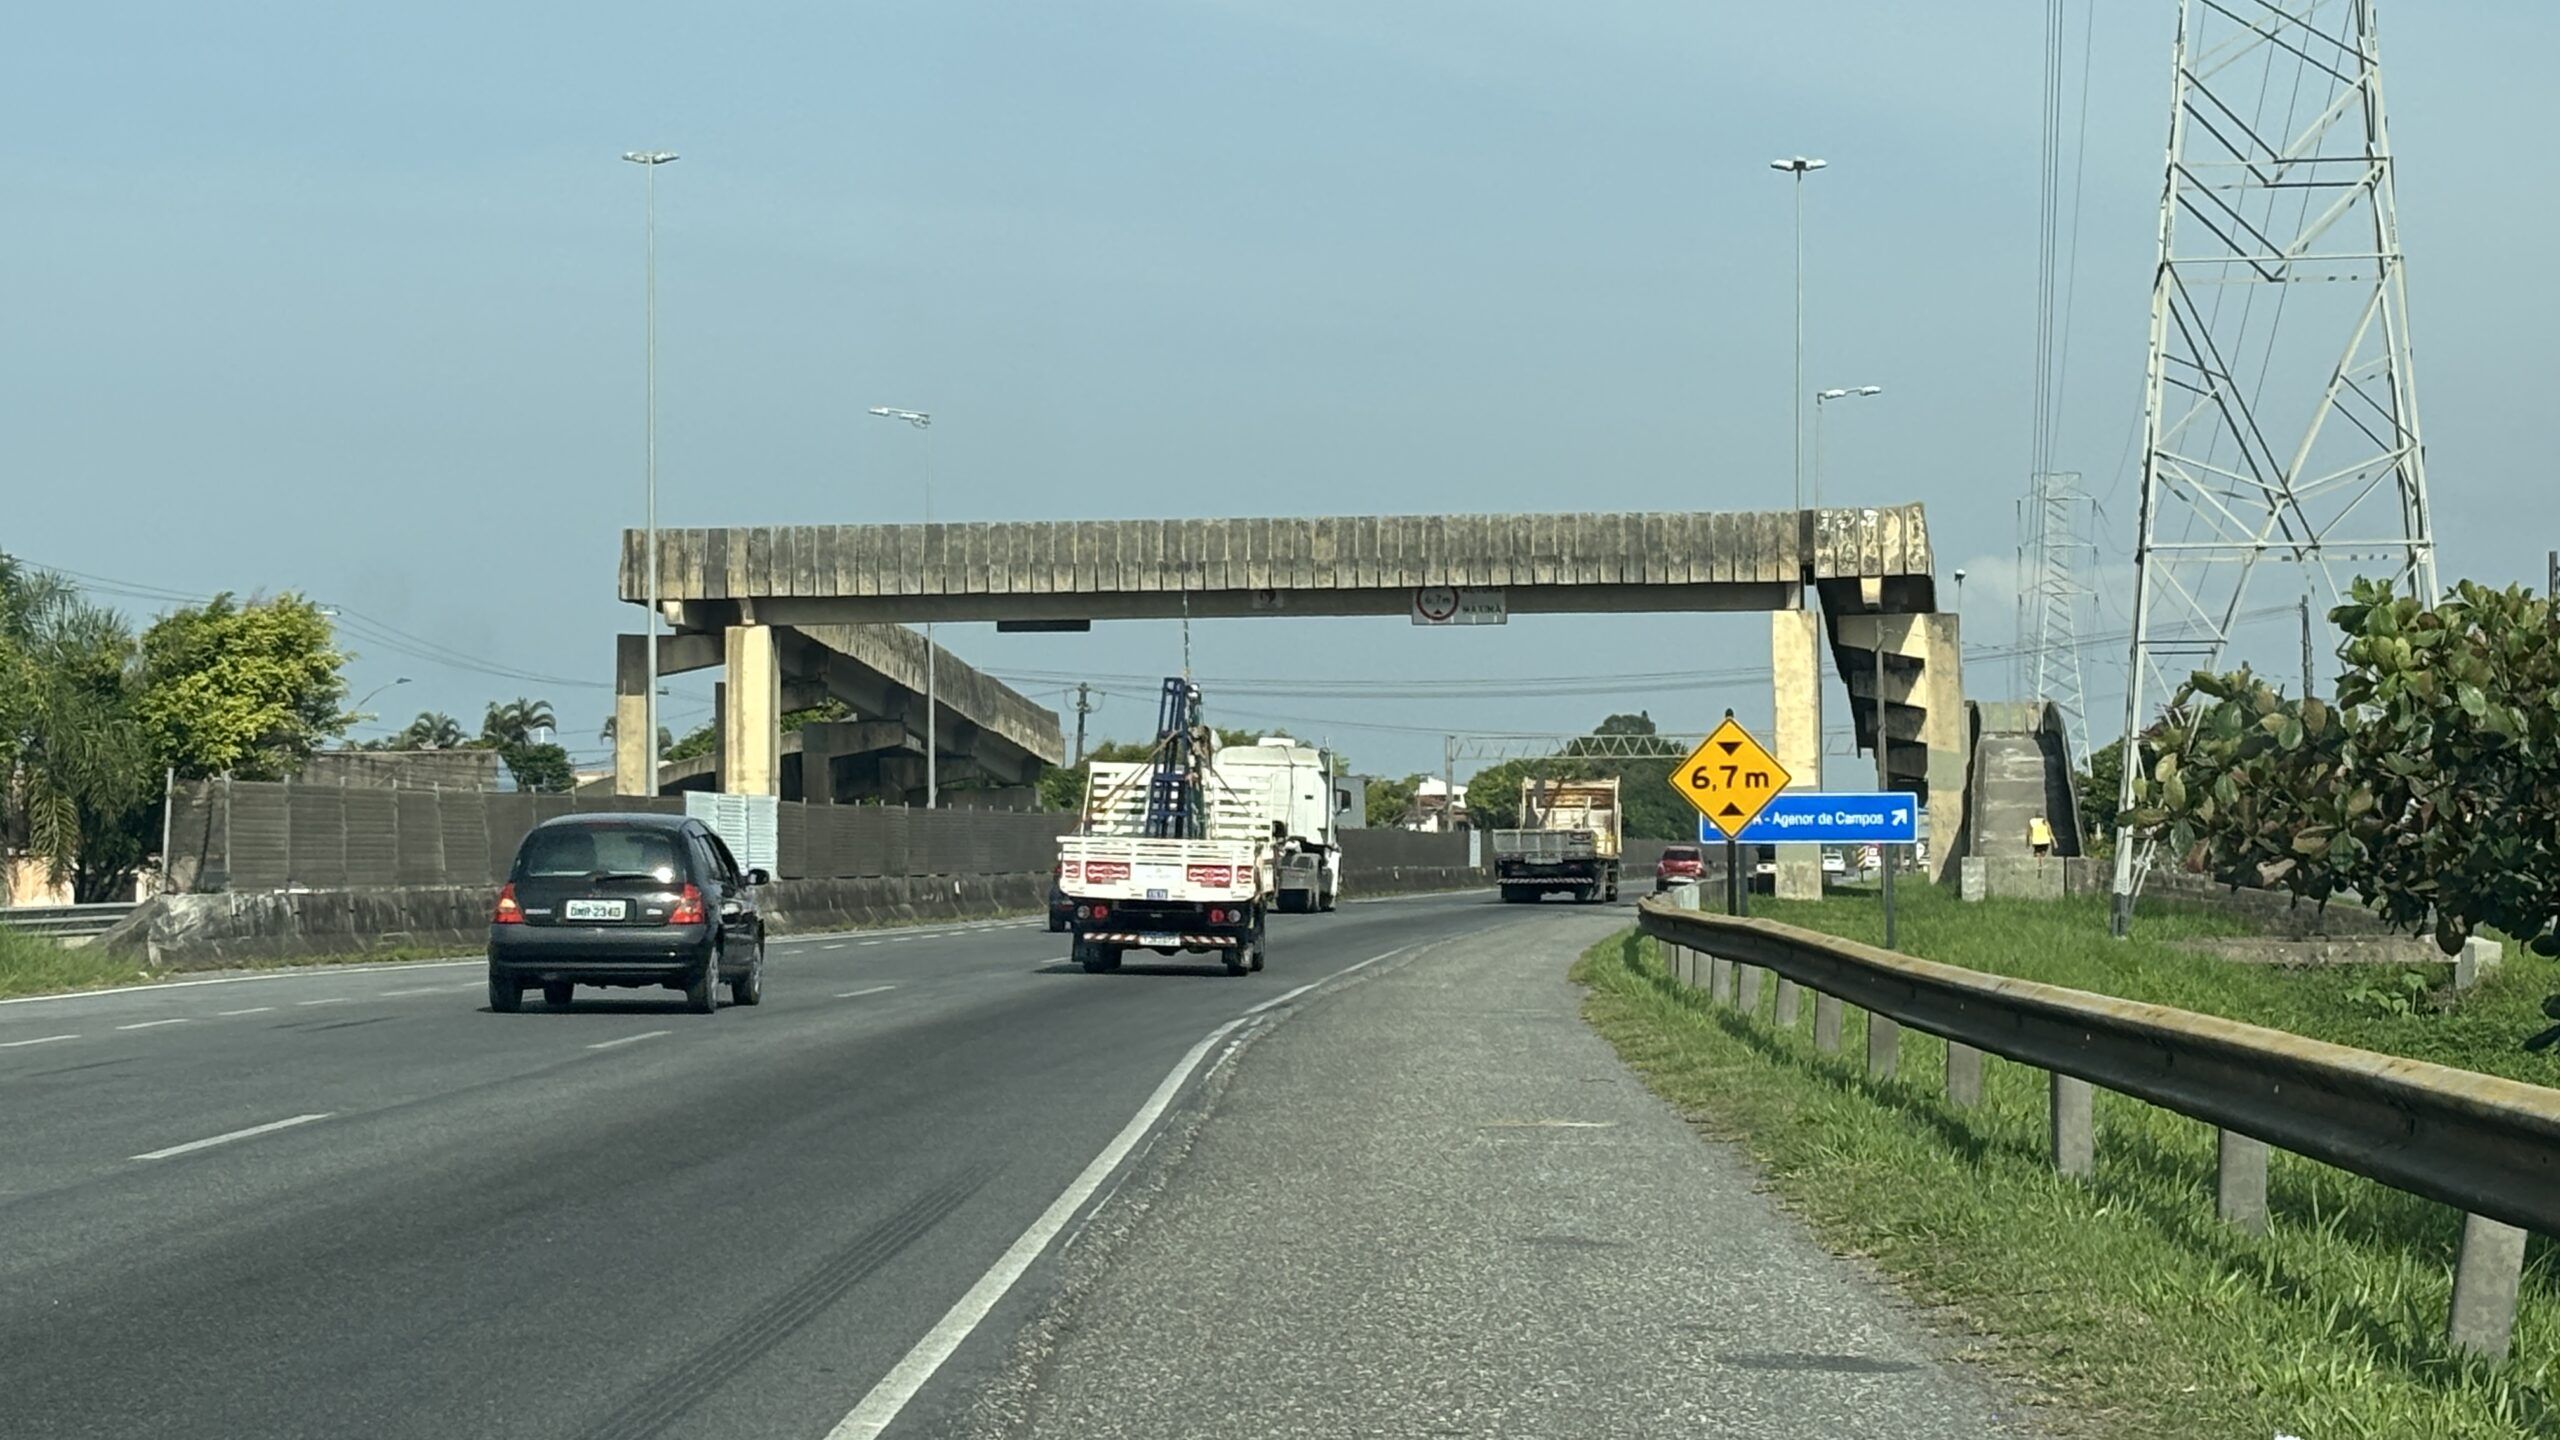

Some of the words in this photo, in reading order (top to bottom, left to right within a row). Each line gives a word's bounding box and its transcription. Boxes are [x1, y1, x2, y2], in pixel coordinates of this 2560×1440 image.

[1773, 811, 1815, 828] Agenor
[1818, 812, 1833, 825] de
[1835, 811, 1884, 828] Campos
